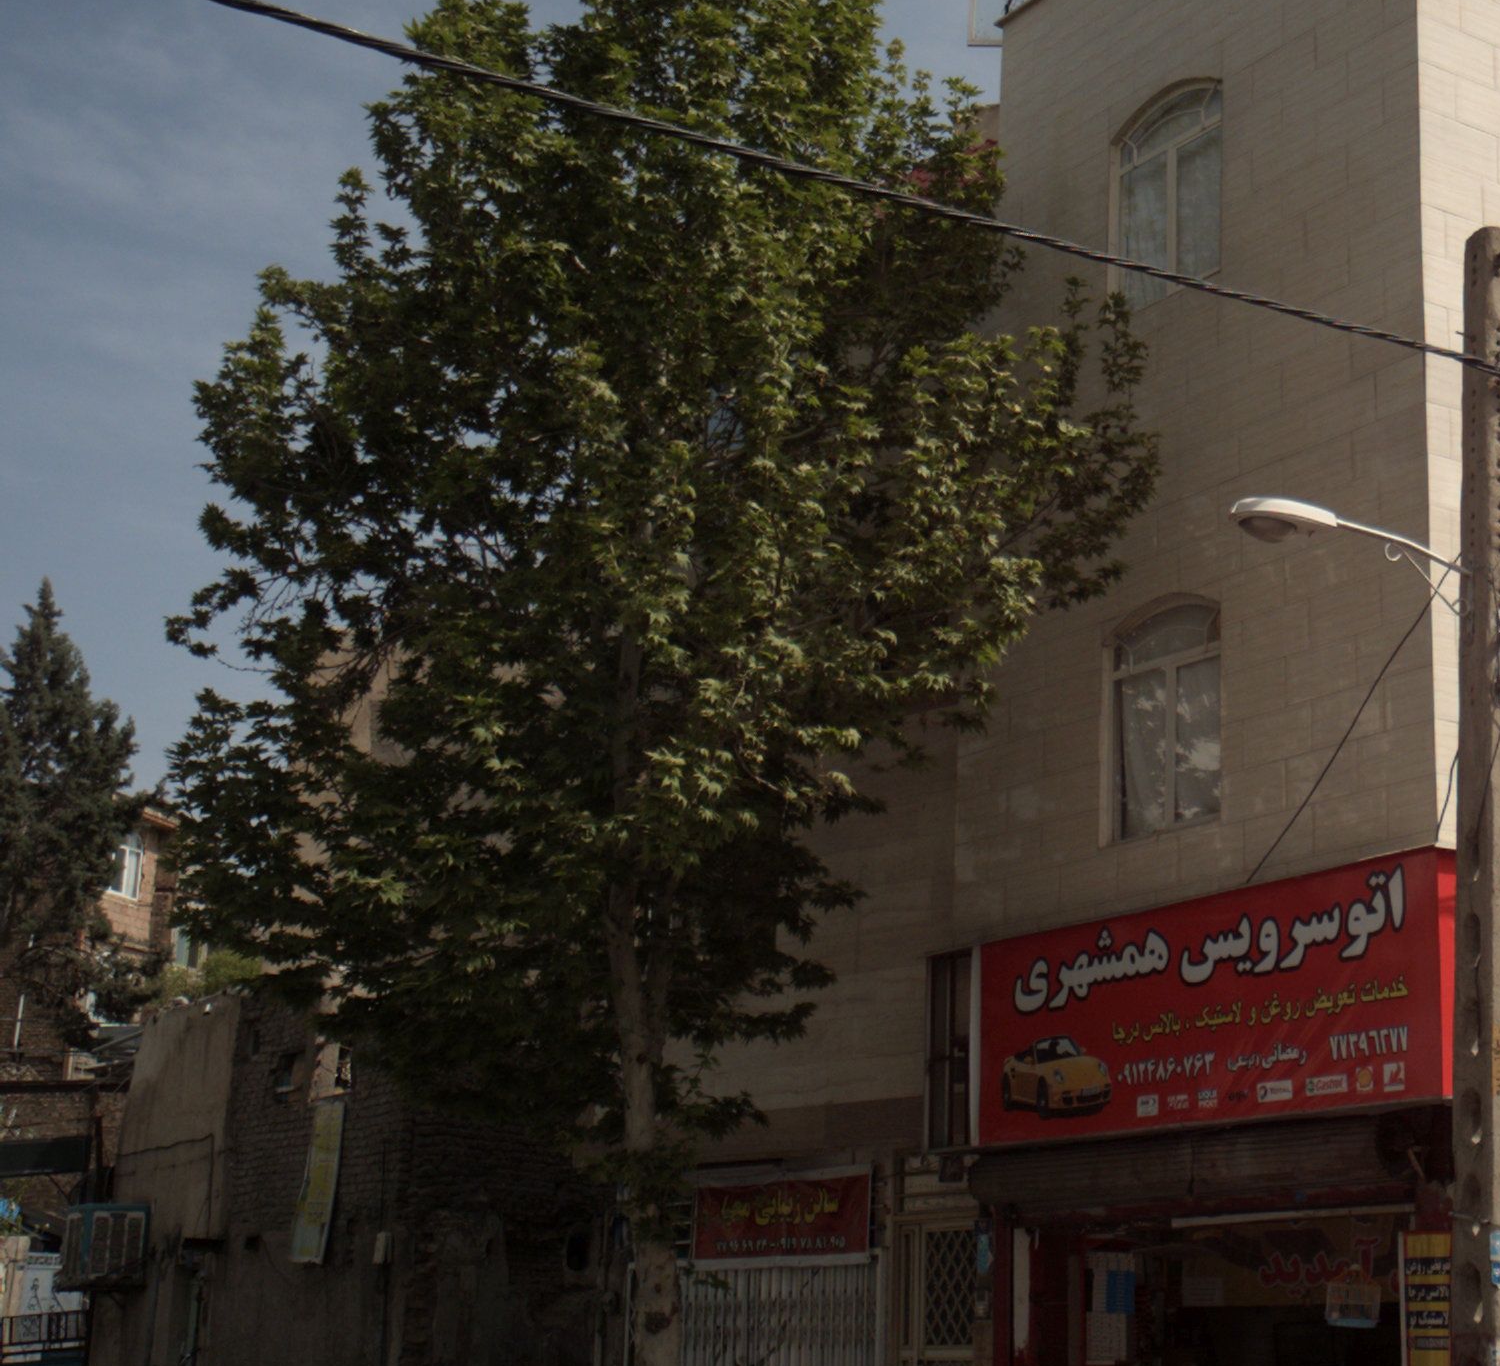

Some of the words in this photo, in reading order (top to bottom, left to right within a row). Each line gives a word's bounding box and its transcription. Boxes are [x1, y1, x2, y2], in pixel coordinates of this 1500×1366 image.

[1013, 925, 1170, 1013] همشهری
[1306, 986, 1357, 1018] تعویض
[1360, 974, 1409, 1002] خدمات
[1195, 1001, 1243, 1031] لاستیک
[1246, 1008, 1258, 1026] و
[1261, 992, 1302, 1026] روغن
[754, 1188, 801, 1226] زیبایی
[804, 1187, 840, 1224] سالن
